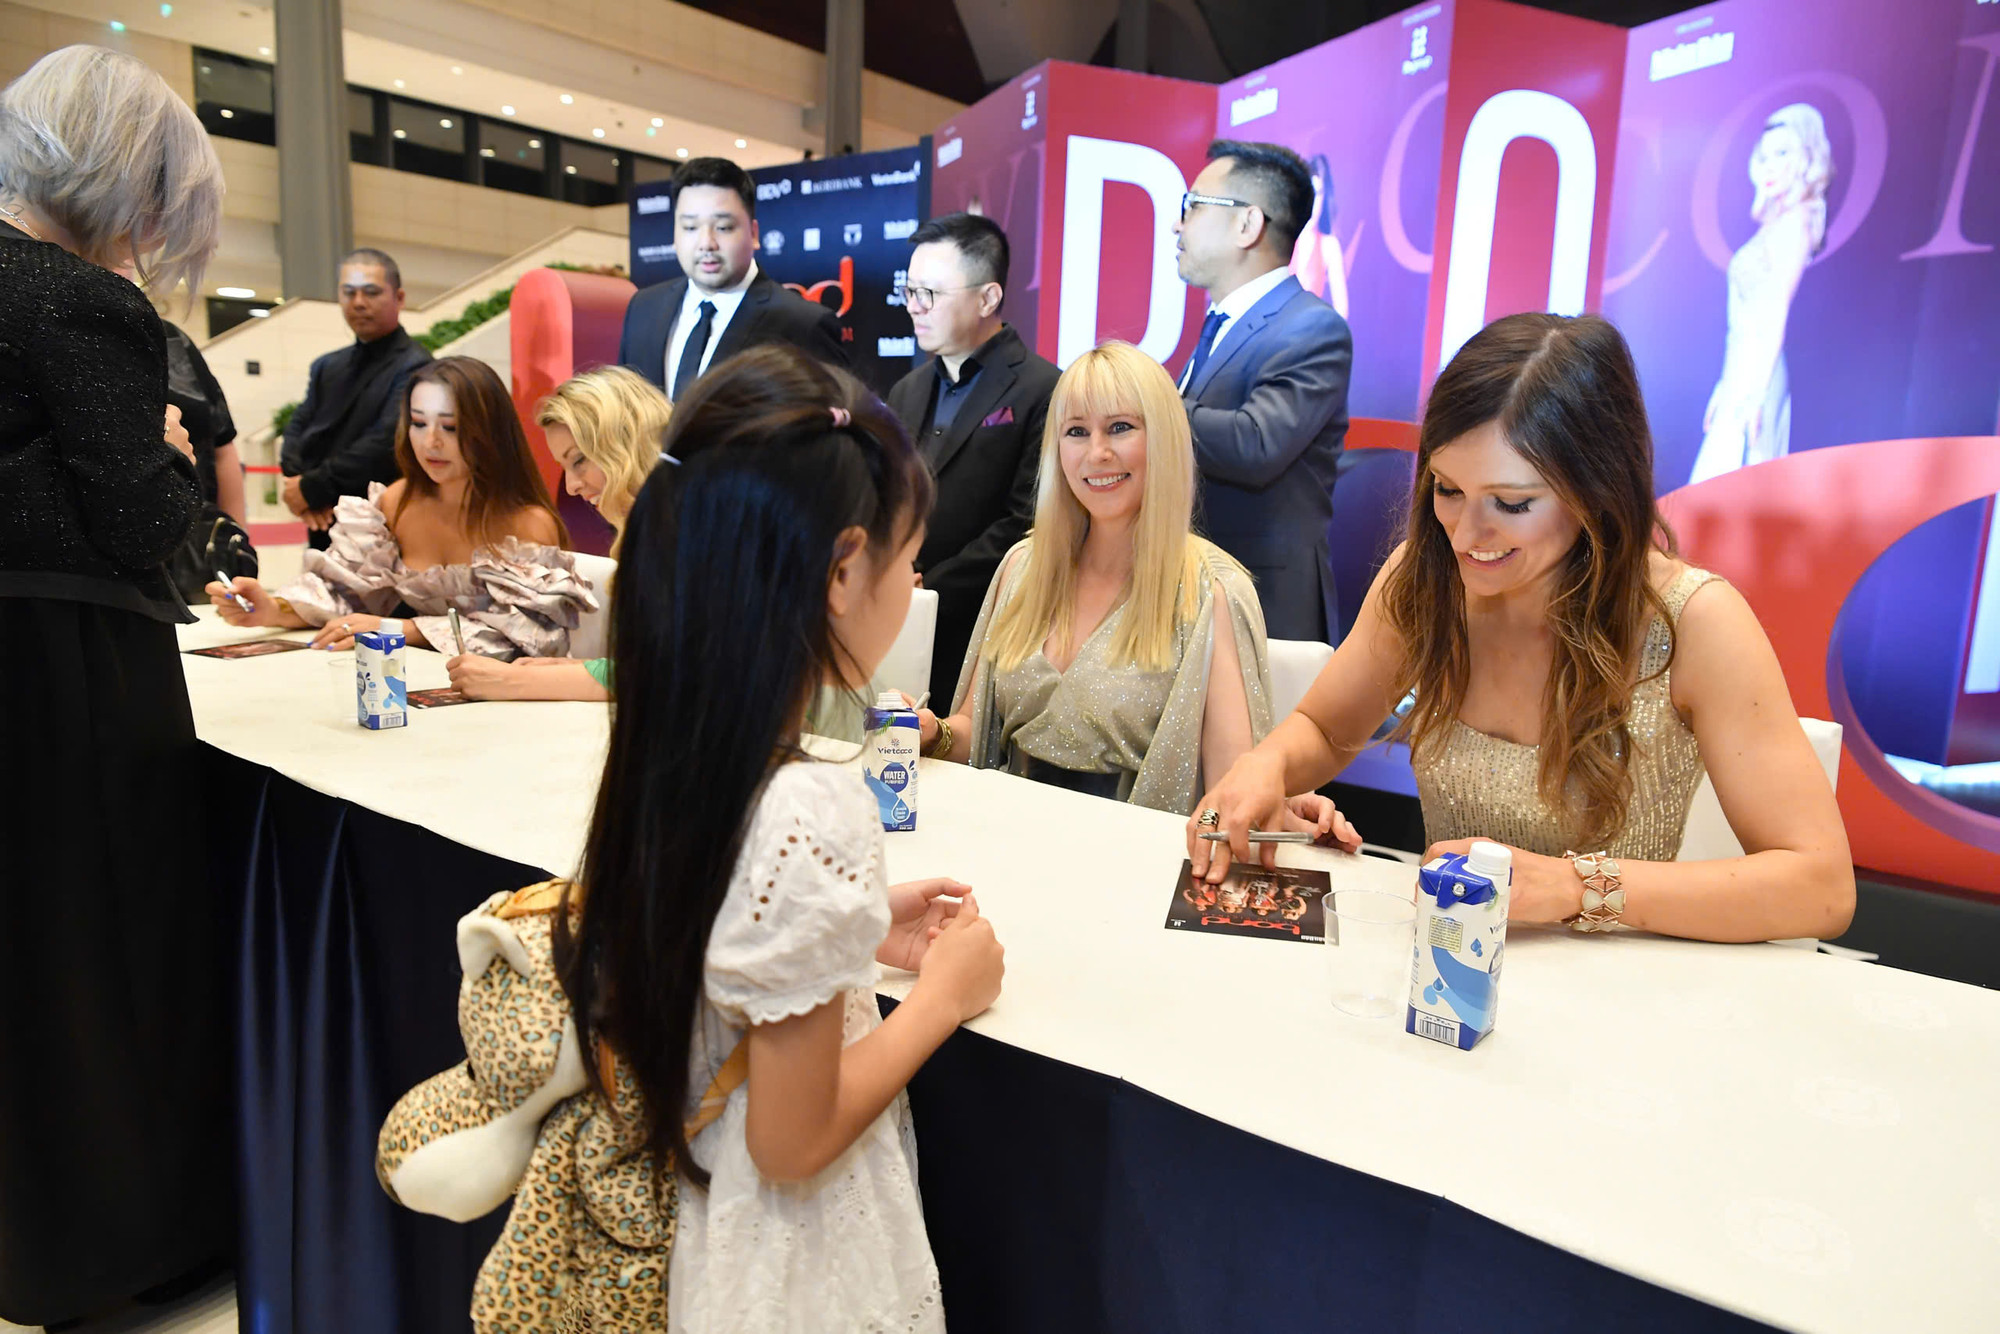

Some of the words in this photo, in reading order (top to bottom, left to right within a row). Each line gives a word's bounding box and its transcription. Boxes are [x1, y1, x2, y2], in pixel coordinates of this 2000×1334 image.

[1057, 135, 1188, 371] D
[877, 746, 913, 755] Vietcoco
[884, 770, 906, 780] WATER
